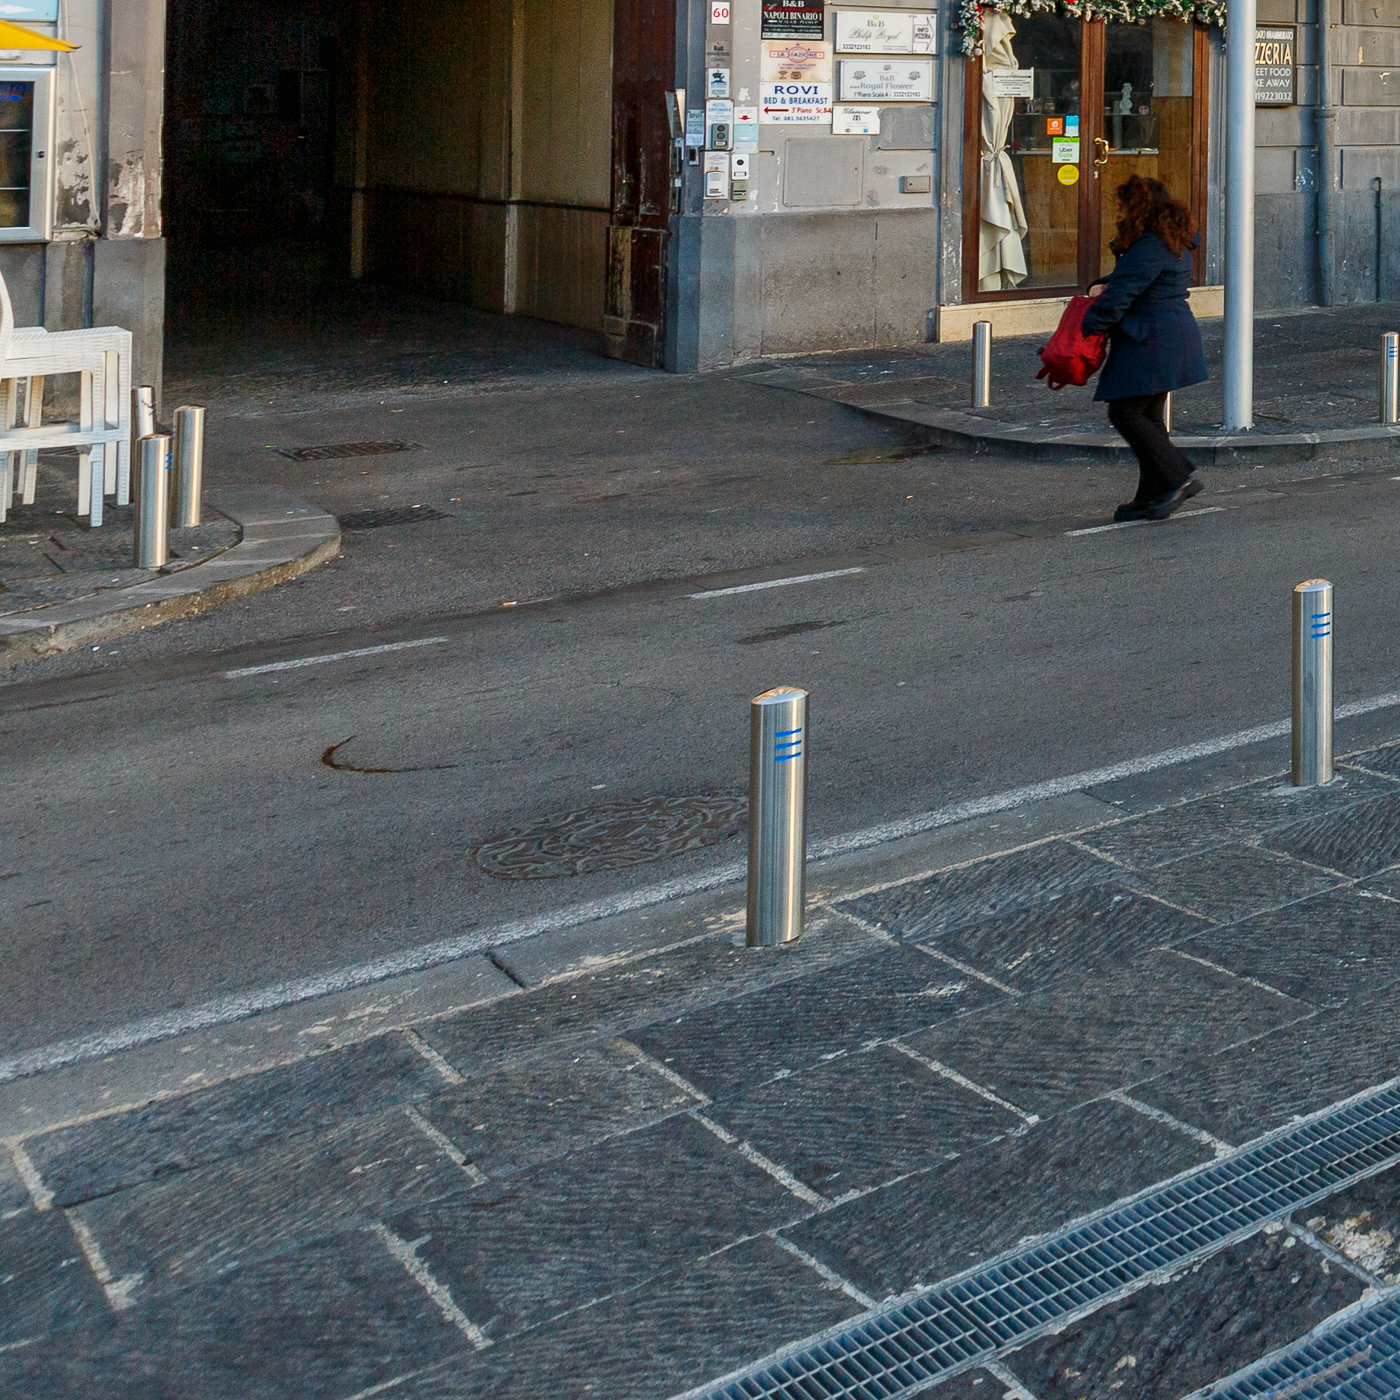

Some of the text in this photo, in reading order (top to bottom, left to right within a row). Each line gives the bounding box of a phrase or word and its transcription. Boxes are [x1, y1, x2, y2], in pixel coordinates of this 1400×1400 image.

[782, 0, 805, 8] B&B
[713, 7, 729, 18] 60
[764, 11, 789, 19] NAPOLI
[790, 12, 818, 20] BINARIO
[1254, 42, 1292, 65] ZZERIA
[1255, 67, 1291, 77] EET FOOD
[860, 82, 914, 91] Royal Flower
[1265, 79, 1291, 87] AWAY
[774, 85, 819, 95] ROVI
[764, 97, 828, 105] BED & BREAKFAST
